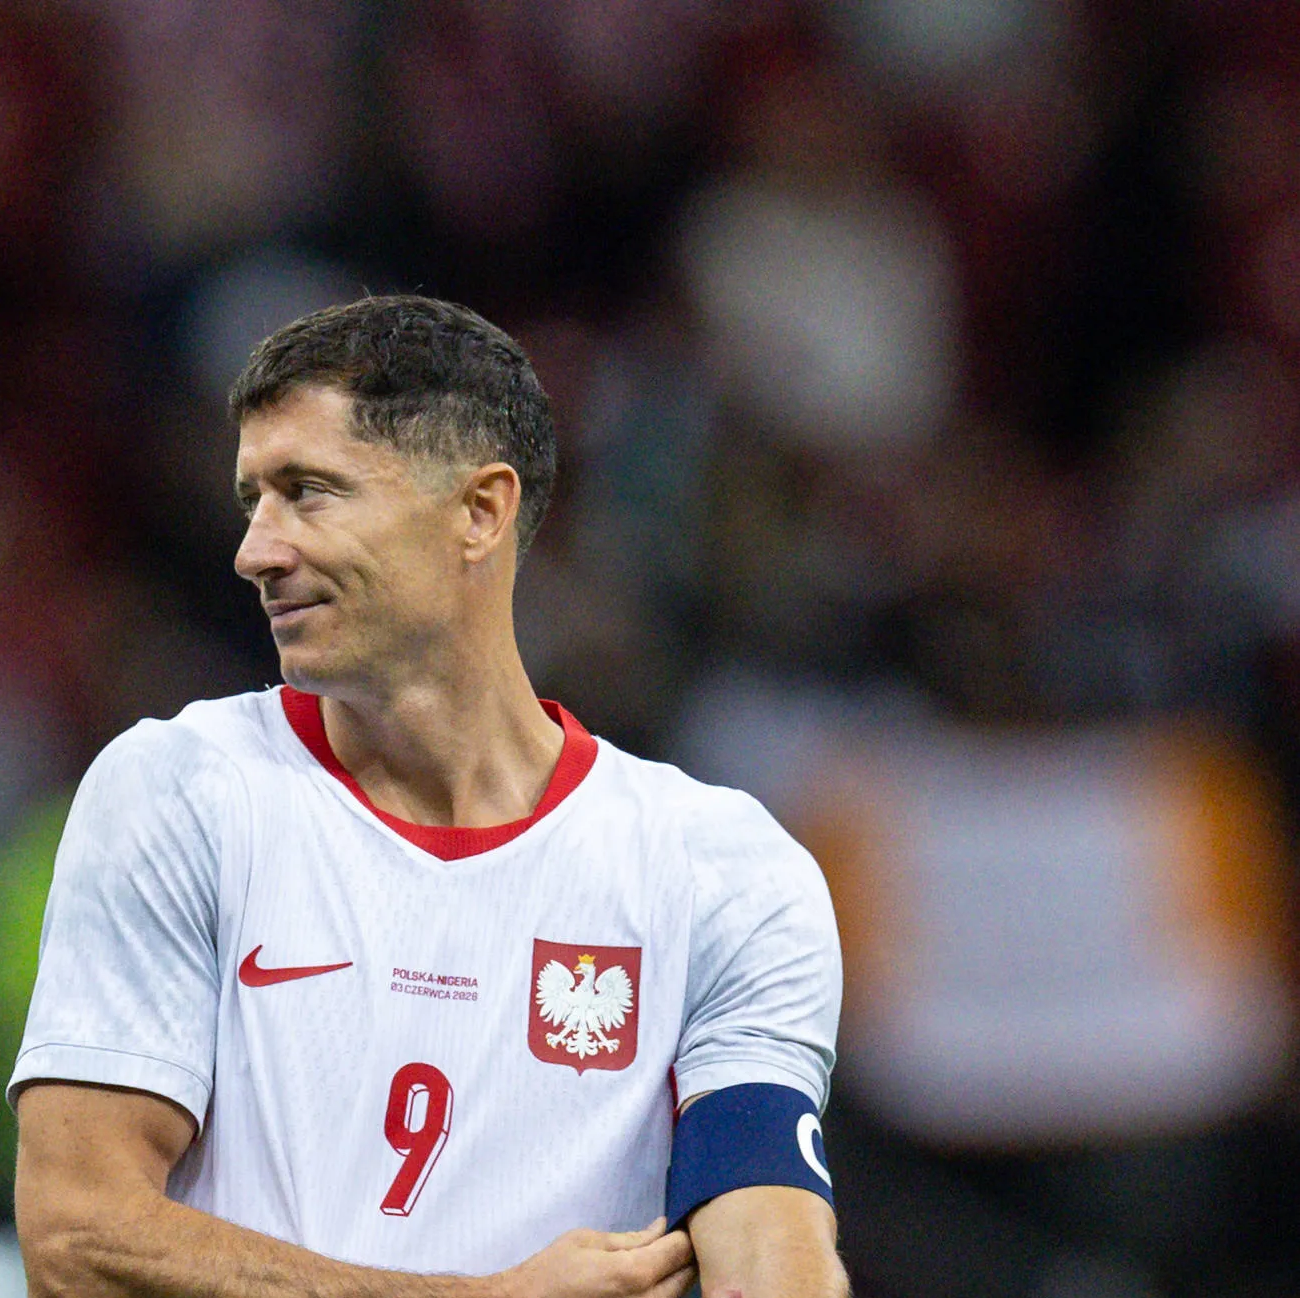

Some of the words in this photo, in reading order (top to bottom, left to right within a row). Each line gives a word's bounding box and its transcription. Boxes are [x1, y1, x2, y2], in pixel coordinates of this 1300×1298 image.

[392, 967, 479, 988] POLSKA-NIGERIA
[390, 982, 404, 993] 03
[404, 984, 451, 1000] CZERWCA
[380, 1062, 454, 1217] 9
